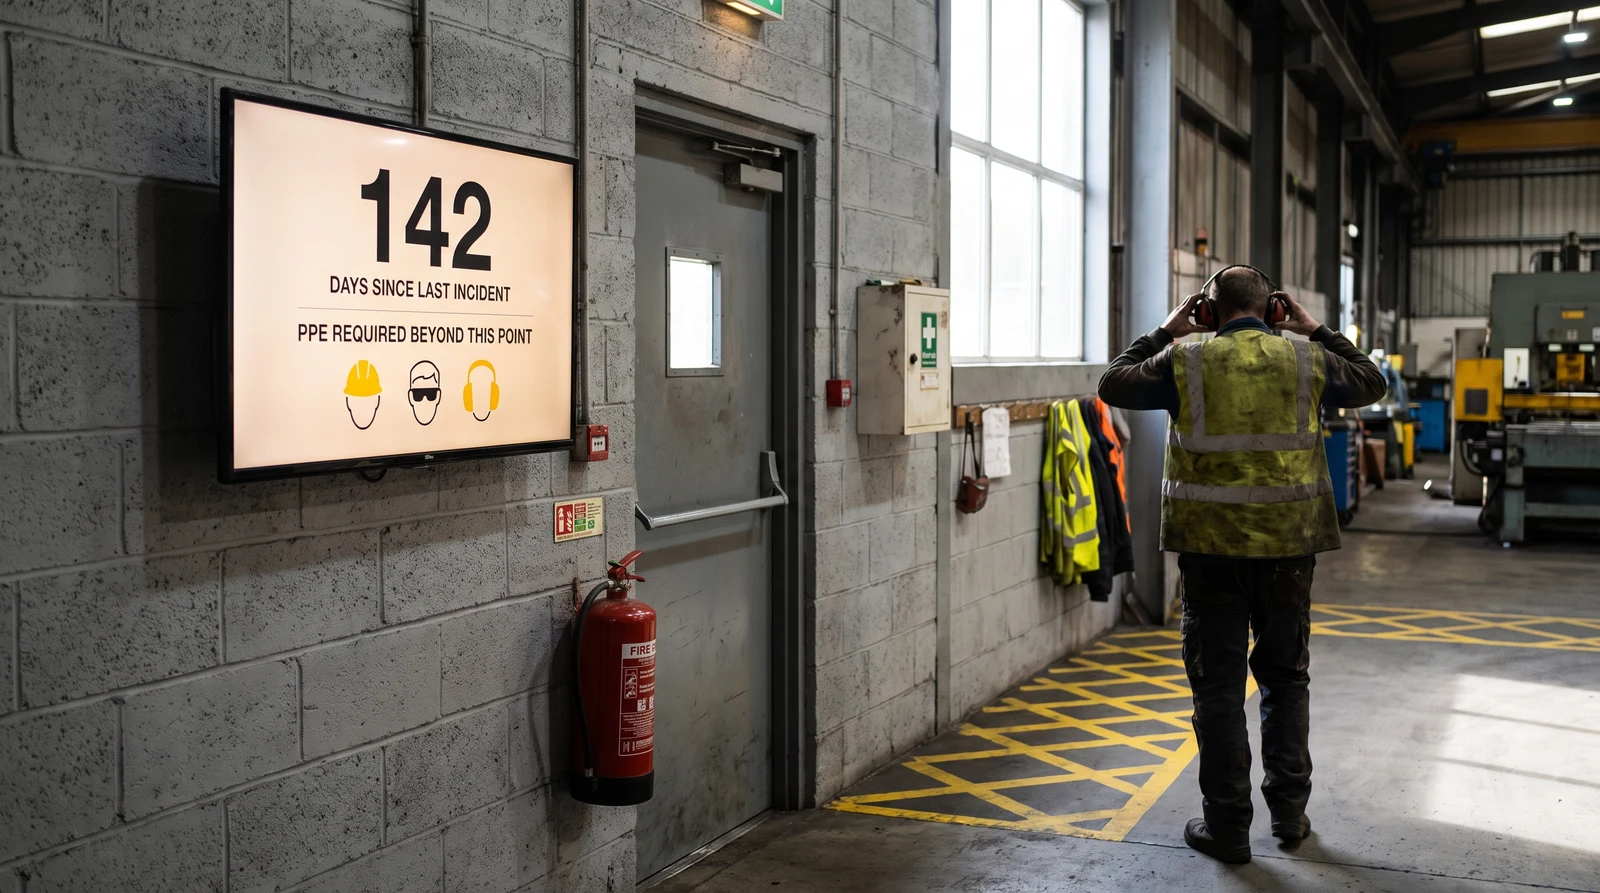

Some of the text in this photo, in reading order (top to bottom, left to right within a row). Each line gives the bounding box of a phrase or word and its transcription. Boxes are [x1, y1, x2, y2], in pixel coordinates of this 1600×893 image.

[360, 168, 492, 272] 142
[330, 275, 511, 302] DAYS SINCE LAST INCIDENT
[298, 323, 533, 345] PPE REQUIRED BEYOND THIS POINT
[630, 644, 651, 656] FIRE
